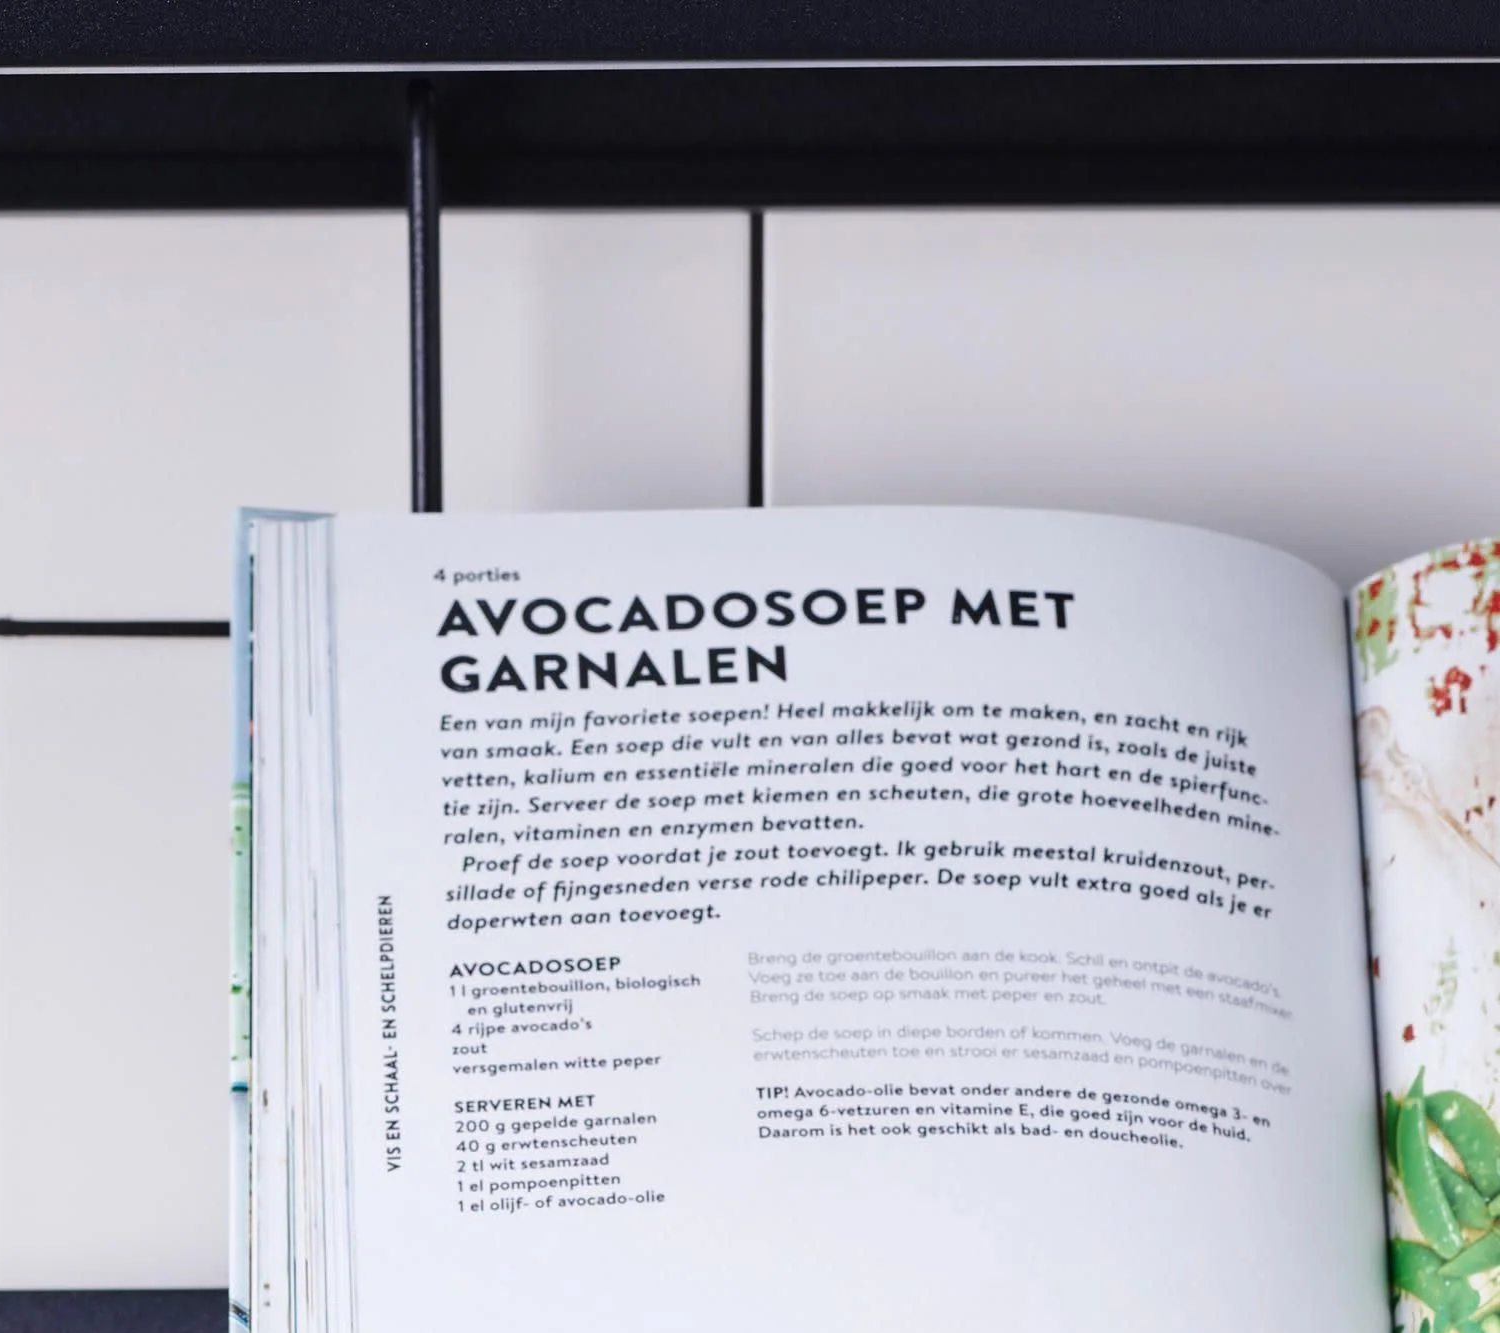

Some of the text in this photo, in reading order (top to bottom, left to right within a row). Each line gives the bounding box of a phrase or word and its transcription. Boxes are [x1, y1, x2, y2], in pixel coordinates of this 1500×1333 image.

[433, 568, 520, 586] 4 porties
[437, 588, 1074, 637] AVOCADOSOEP MET
[441, 645, 787, 693] GARNALEN
[440, 701, 1247, 748] Een van mijn favoriete soepen! Heel makkelijk om te maken, en zacht en rijk
[441, 729, 1256, 776] van smaak. Een soep die vult en van alles bevat wat gezond is, zoals de juiste
[442, 757, 1267, 805] vetten, kalium en essentiële mineralen die goed voor het hart en de spierfunc-
[443, 784, 1279, 836] tie zijn. Serveer de soep met kiemen en scheuten, die grote hoeveelheden mine-
[444, 816, 864, 845] ralen, vitaminen en enzymen bevatten.
[462, 840, 1274, 889] Proef de soep voordat je zout toevoegt. Ik gebruik meestal kruidenzout, per-
[447, 904, 720, 934] doperwten aan toevoegt.
[449, 956, 621, 978] AVOCADOSOEP
[450, 974, 700, 999] 1 l groentebouillon, biologisch
[467, 999, 573, 1018] en glutenvrij
[378, 895, 401, 1172] VIS EN SCHAAL- EN SCHELPDIEREN
[452, 1018, 592, 1038] 4 rijpe avocado's
[453, 1043, 487, 1055] zout
[453, 1056, 661, 1077] versgemalen witte peper
[455, 1094, 595, 1113] SERVEREN MET
[756, 1083, 1270, 1127] TIP! Avocado-olie bevat onder andere de gezonde omega 3- en
[456, 1112, 657, 1135] 200 g gepelde garnalen
[757, 1103, 1250, 1142] omega 6-vetzuren en vitamine E, die goed zijn voor de huid.
[759, 1122, 1183, 1148] Daarom is het ook geschikt als bad- en doucheolie.
[456, 1134, 637, 1155] 40 g erwtenscheuten
[457, 1153, 609, 1173] 2 tl wit sesamzaad
[458, 1174, 620, 1194] 1 el pompoenpitten
[458, 1190, 665, 1214] 1 el olijf- of avocado-olie
